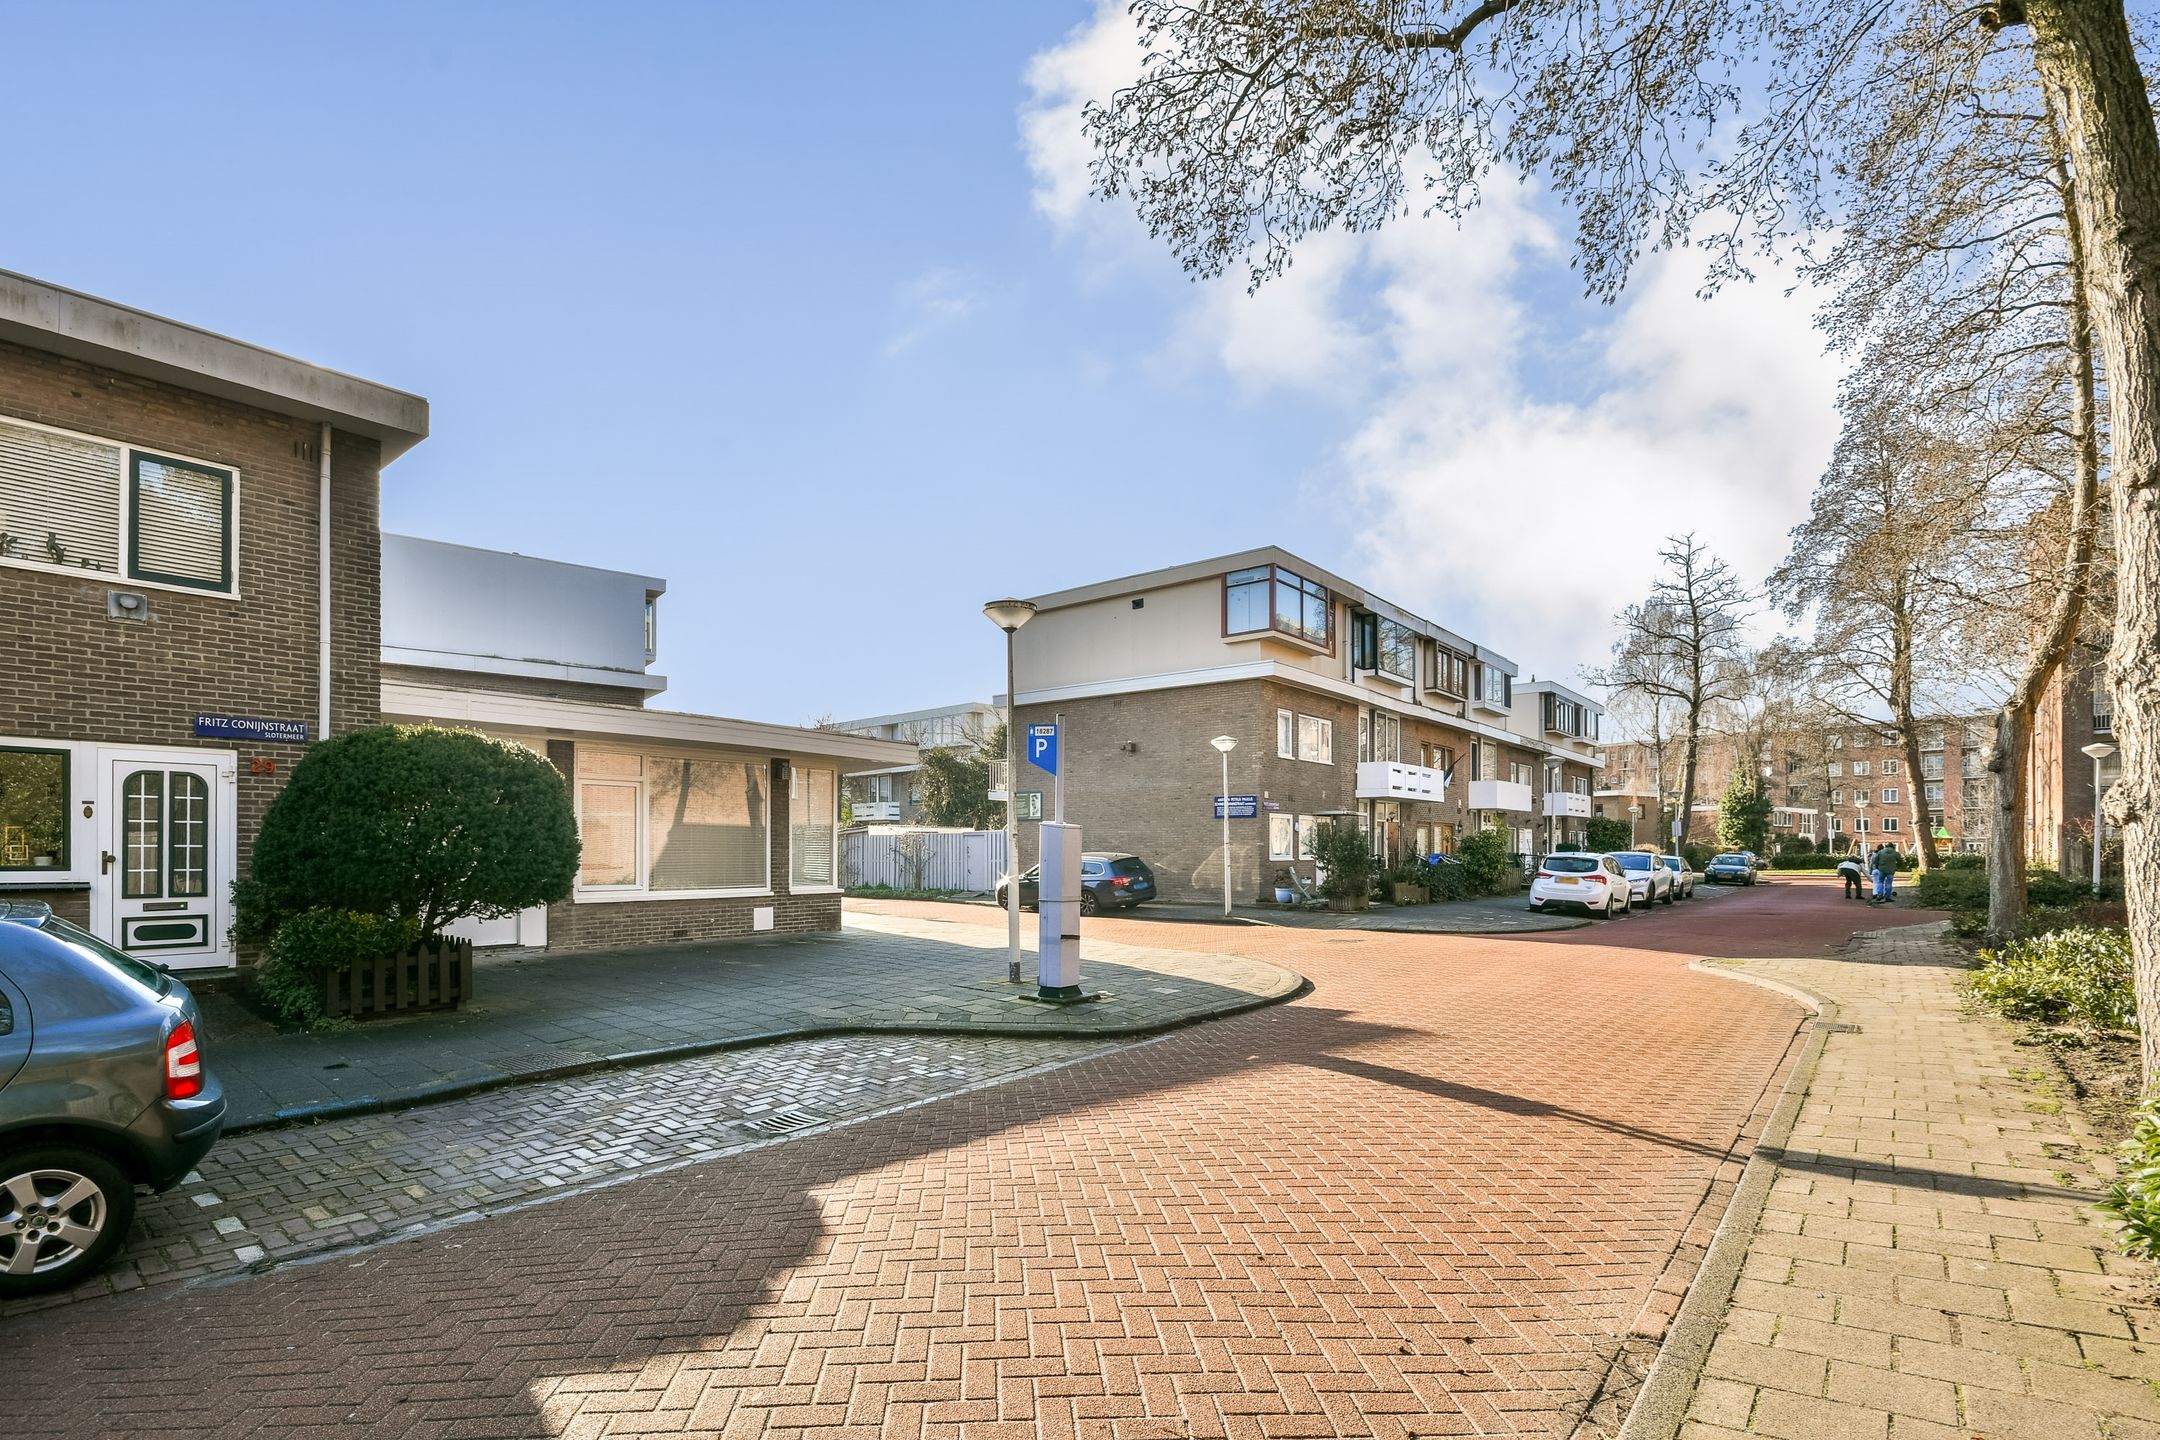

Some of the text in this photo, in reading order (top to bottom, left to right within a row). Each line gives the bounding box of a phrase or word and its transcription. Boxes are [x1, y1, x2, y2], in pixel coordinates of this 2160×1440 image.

[198, 716, 304, 733] FRITZ CONIJNSTRAAT
[264, 732, 304, 740] SLOTERMEER
[1036, 739, 1048, 758] P
[250, 757, 275, 773] 29
